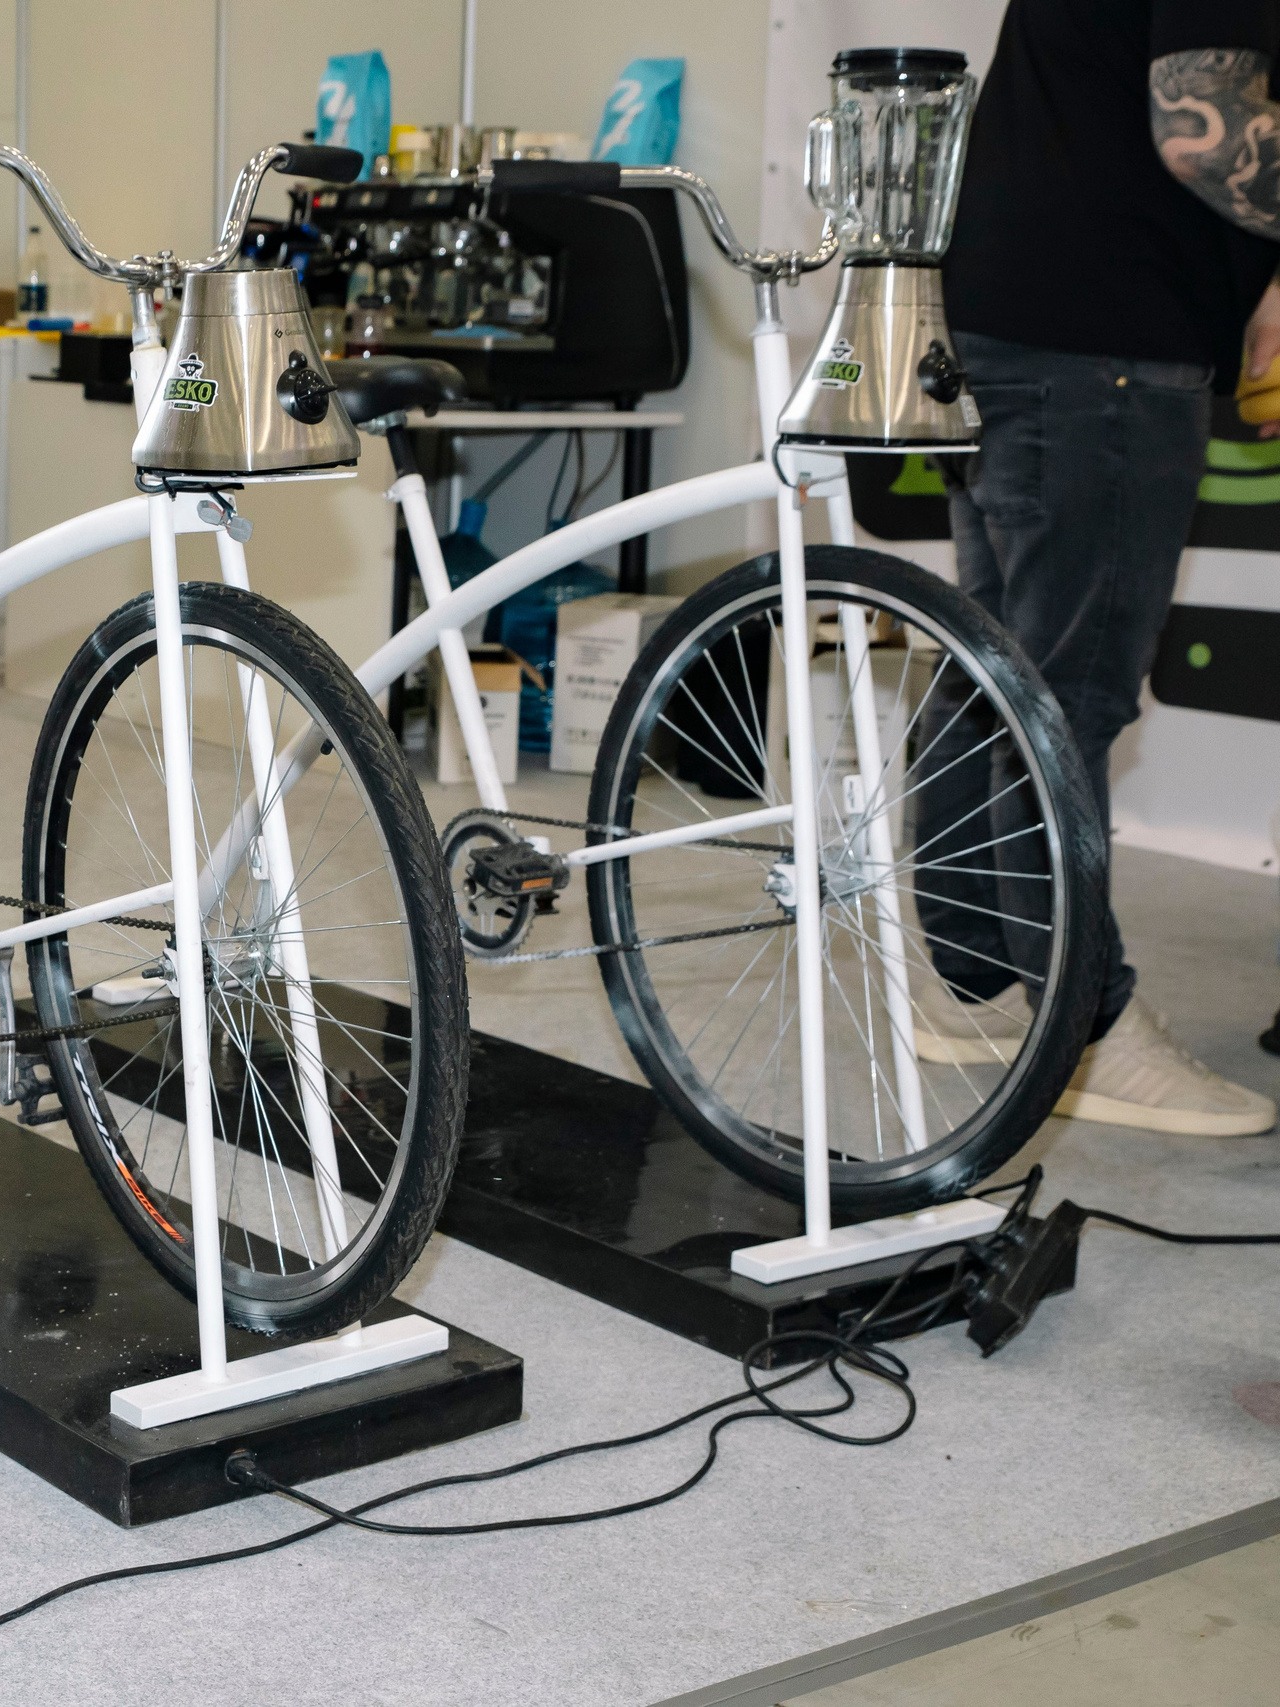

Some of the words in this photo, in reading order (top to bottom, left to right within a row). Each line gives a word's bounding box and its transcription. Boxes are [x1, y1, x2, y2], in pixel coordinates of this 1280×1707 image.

[814, 361, 859, 381] SKO
[166, 380, 212, 402] ESKO
[73, 1052, 126, 1167] TRIX
